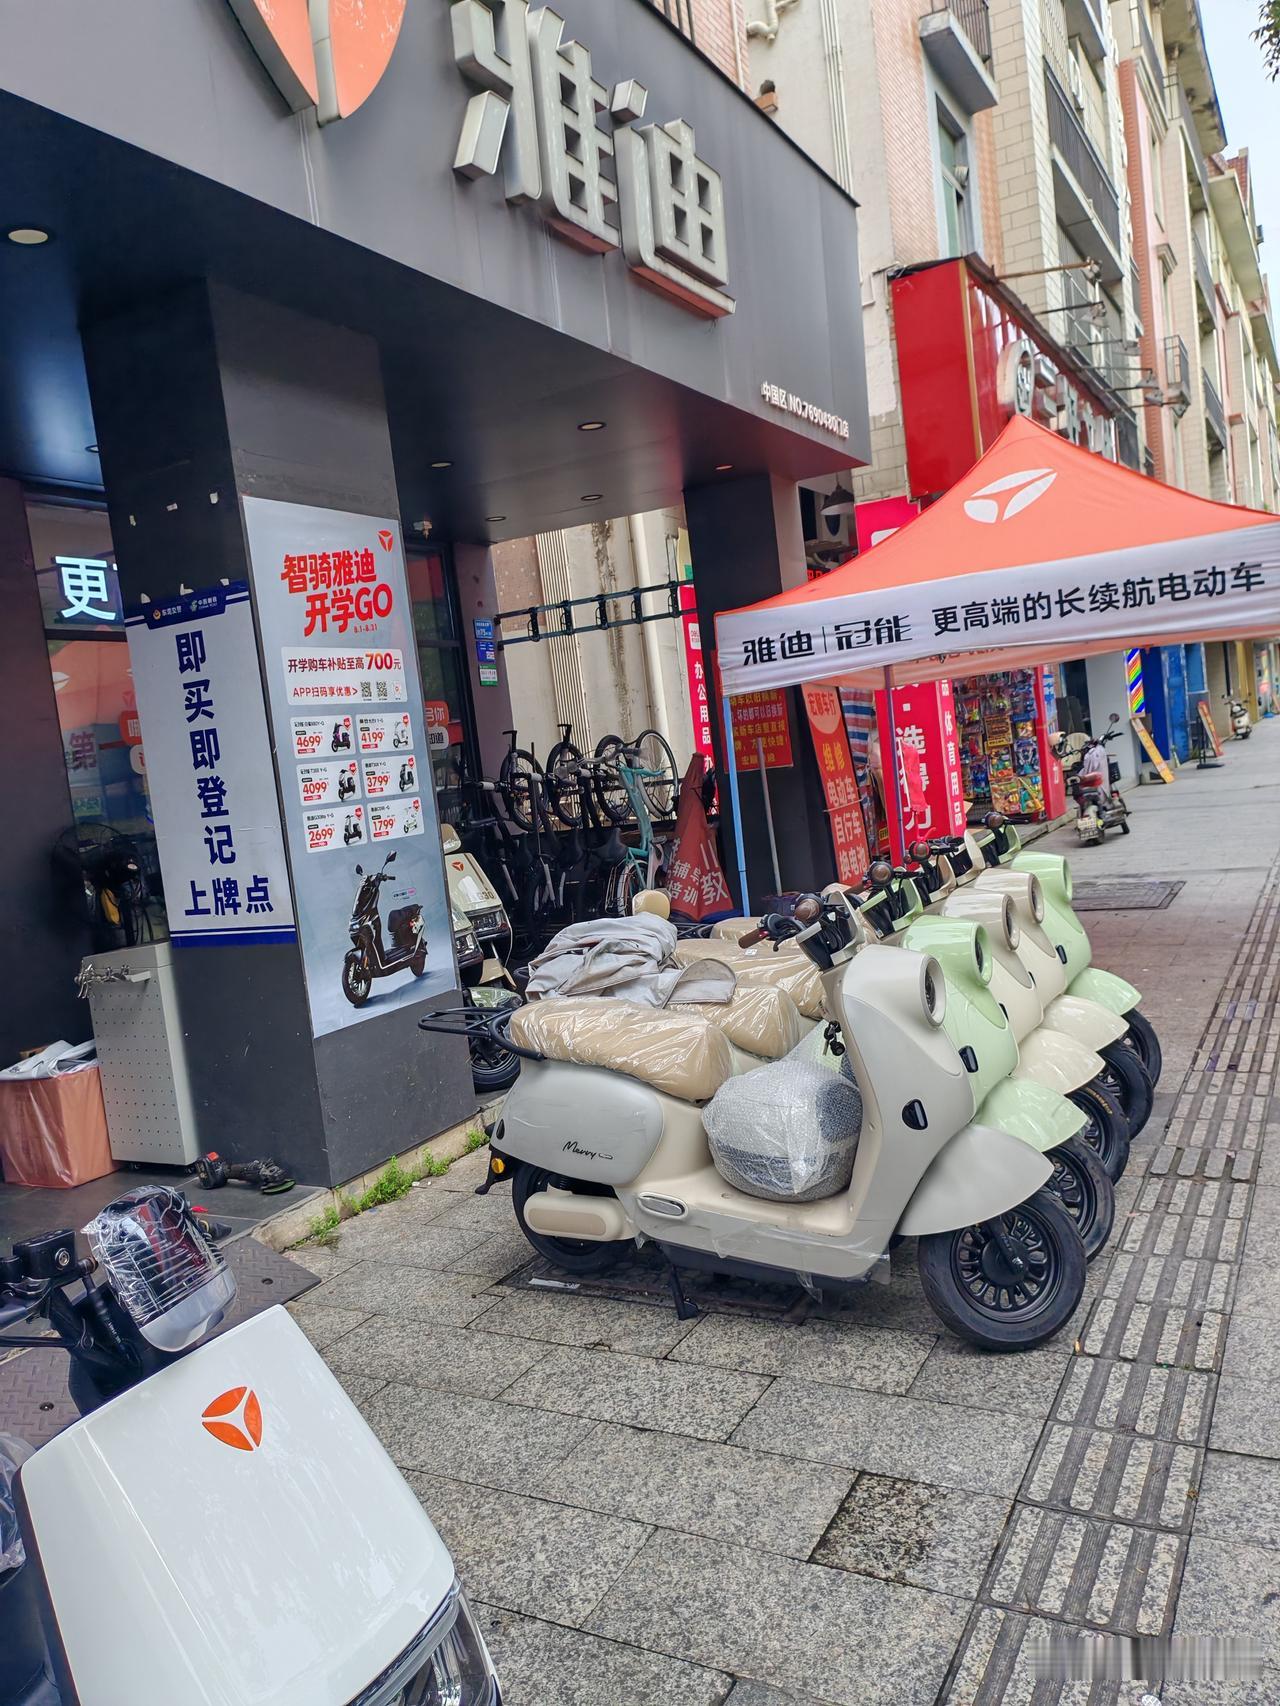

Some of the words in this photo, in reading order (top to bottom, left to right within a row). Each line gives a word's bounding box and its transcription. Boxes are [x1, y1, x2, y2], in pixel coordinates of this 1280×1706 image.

[450, 0, 736, 318] 雅迪
[761, 381, 788, 410] 中国区
[281, 548, 376, 593] 智骑雅迪
[55, 556, 116, 621] 更
[304, 583, 393, 637] 开学GO
[742, 630, 815, 667] 雅迪
[834, 614, 913, 651] 冠能
[932, 561, 1265, 637] 更高端的长续航电动车
[288, 653, 402, 673] 开学购车补贴至高700元
[175, 630, 237, 866] 即买即登记
[297, 735, 321, 748] 4699
[361, 731, 384, 743] 4199
[303, 781, 327, 795] 4099
[367, 775, 389, 787] 3799
[827, 776, 856, 808] 电动车
[308, 828, 333, 842] 2699
[373, 818, 394, 831] 1799
[834, 810, 862, 845] 自行车
[184, 874, 275, 916] 上牌点
